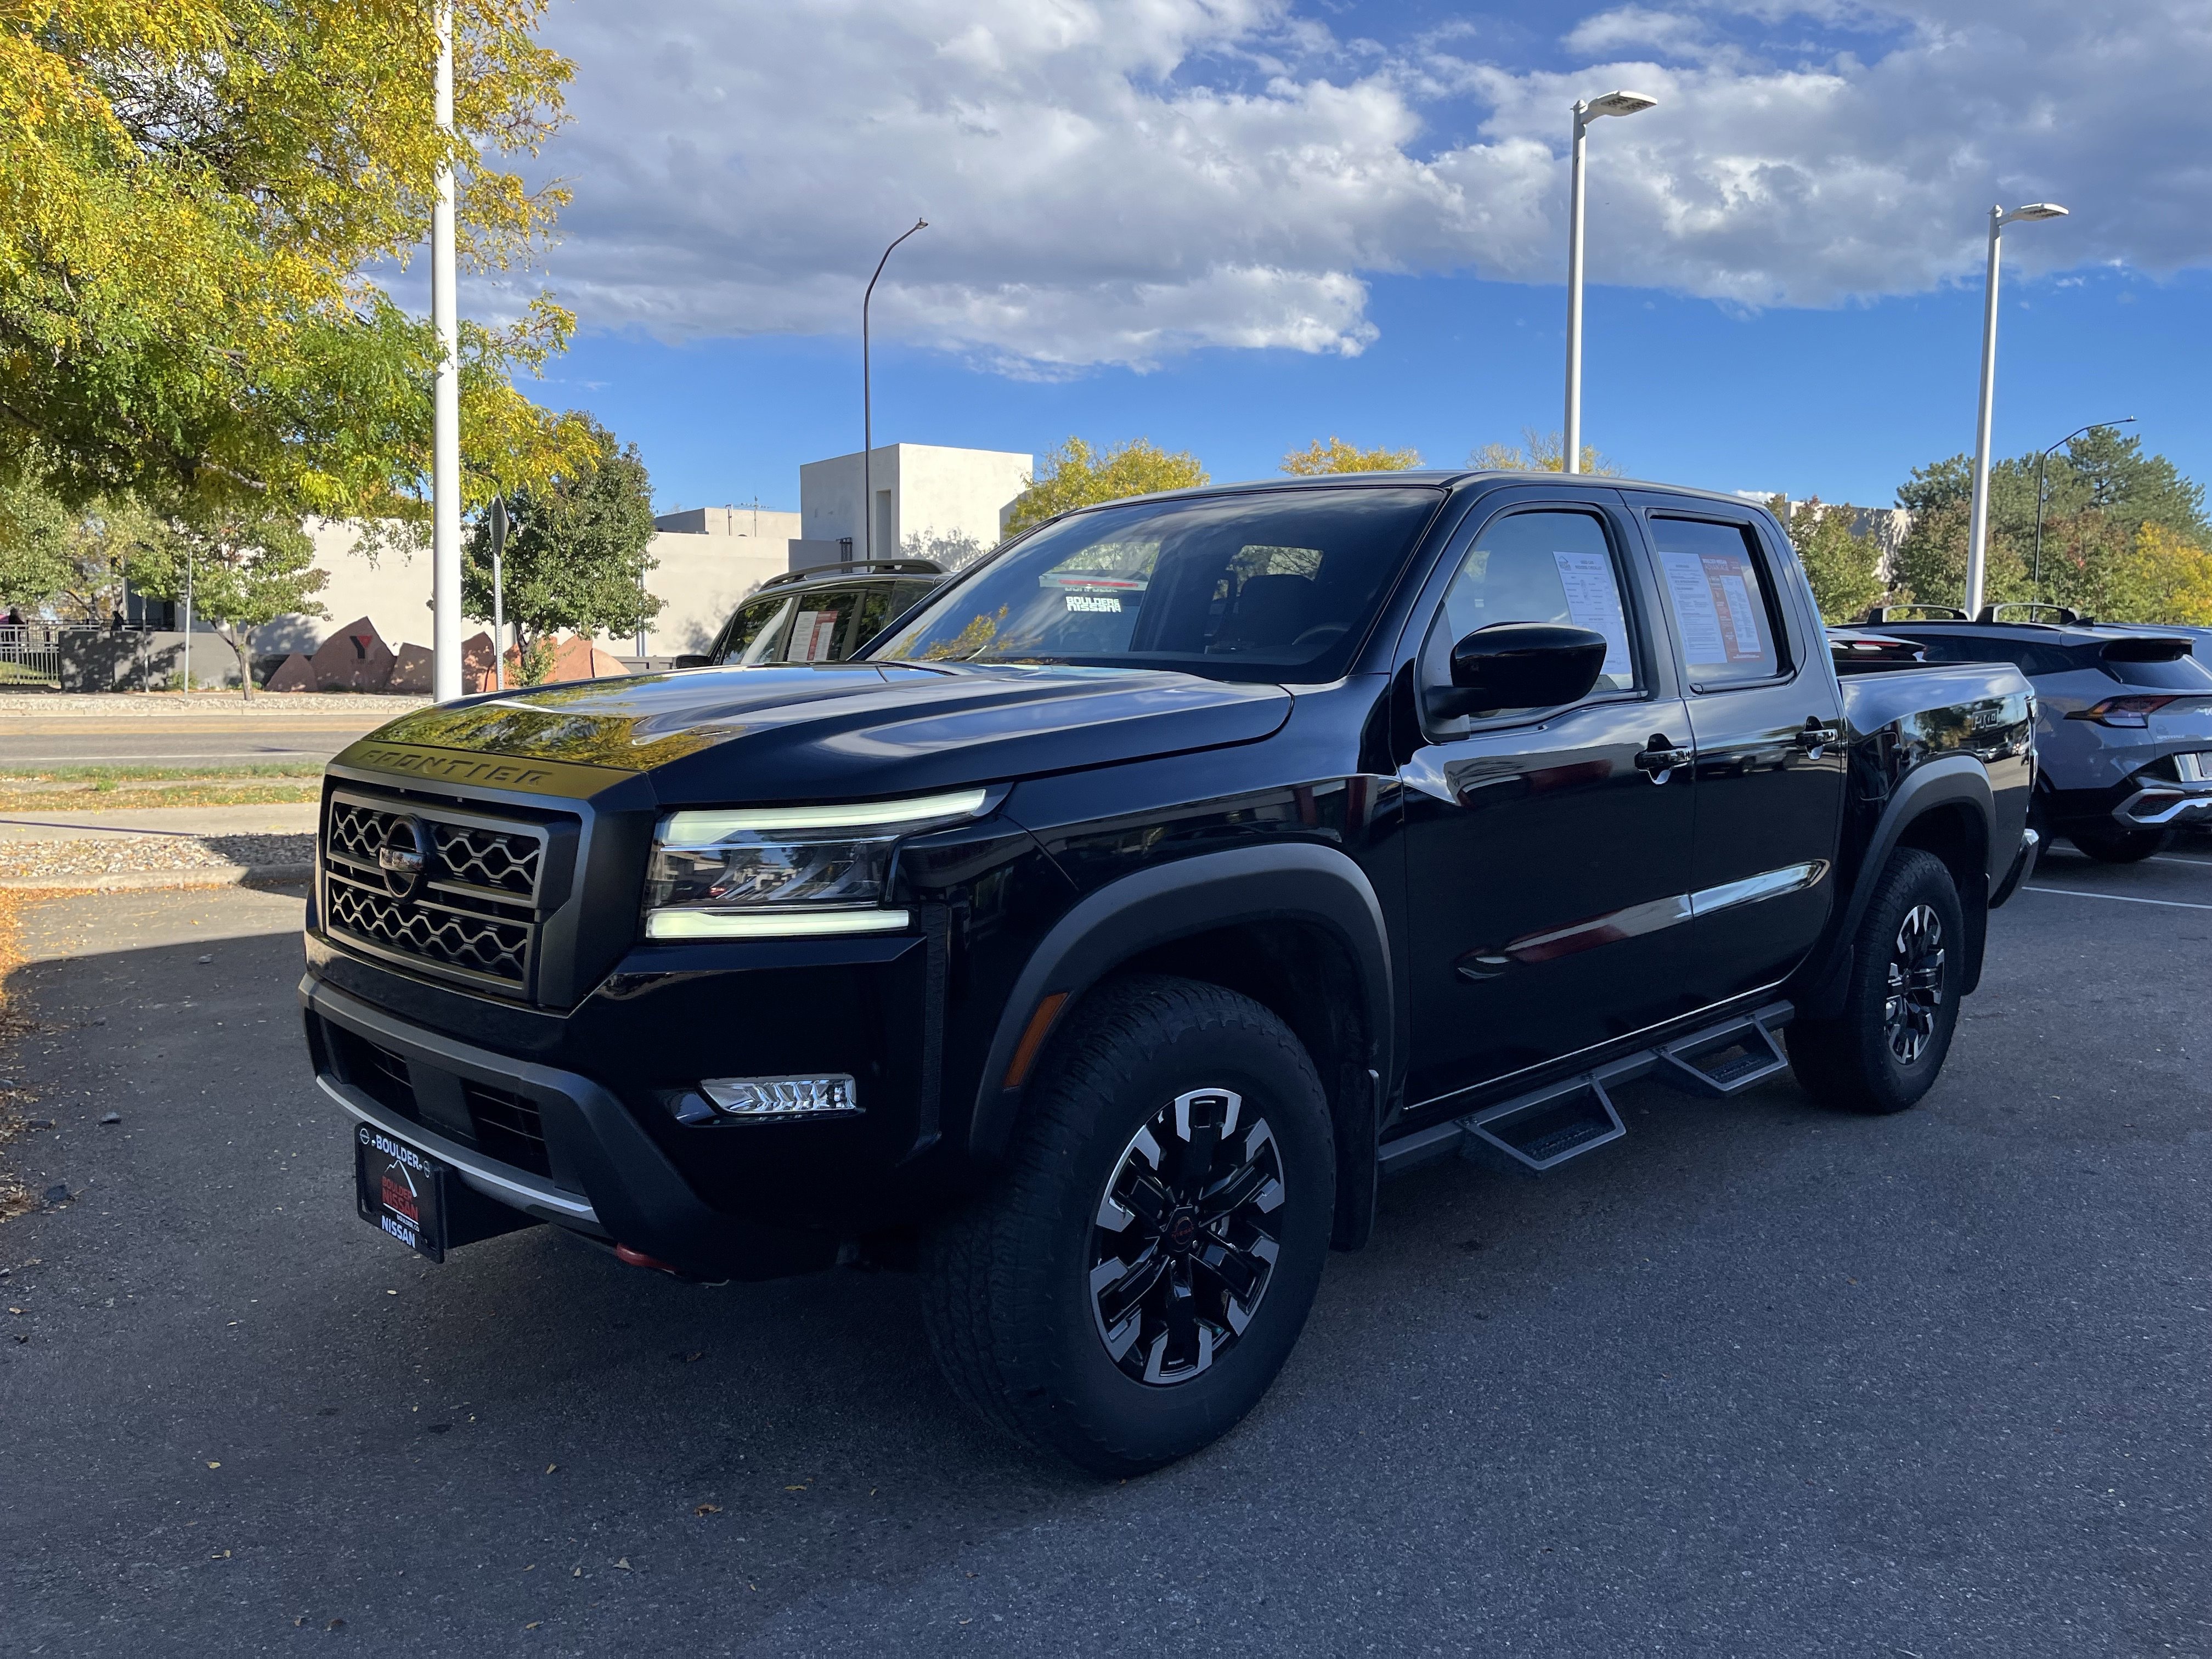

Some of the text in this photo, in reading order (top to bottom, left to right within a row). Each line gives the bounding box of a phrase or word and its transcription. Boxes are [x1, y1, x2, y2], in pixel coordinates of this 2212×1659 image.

[1066, 596, 1114, 606] BOULDER
[357, 749, 553, 786] FRONTIER
[376, 1135, 419, 1170] BOULDER
[382, 1187, 419, 1221] NISSAN
[382, 1215, 415, 1248] NISSAN
